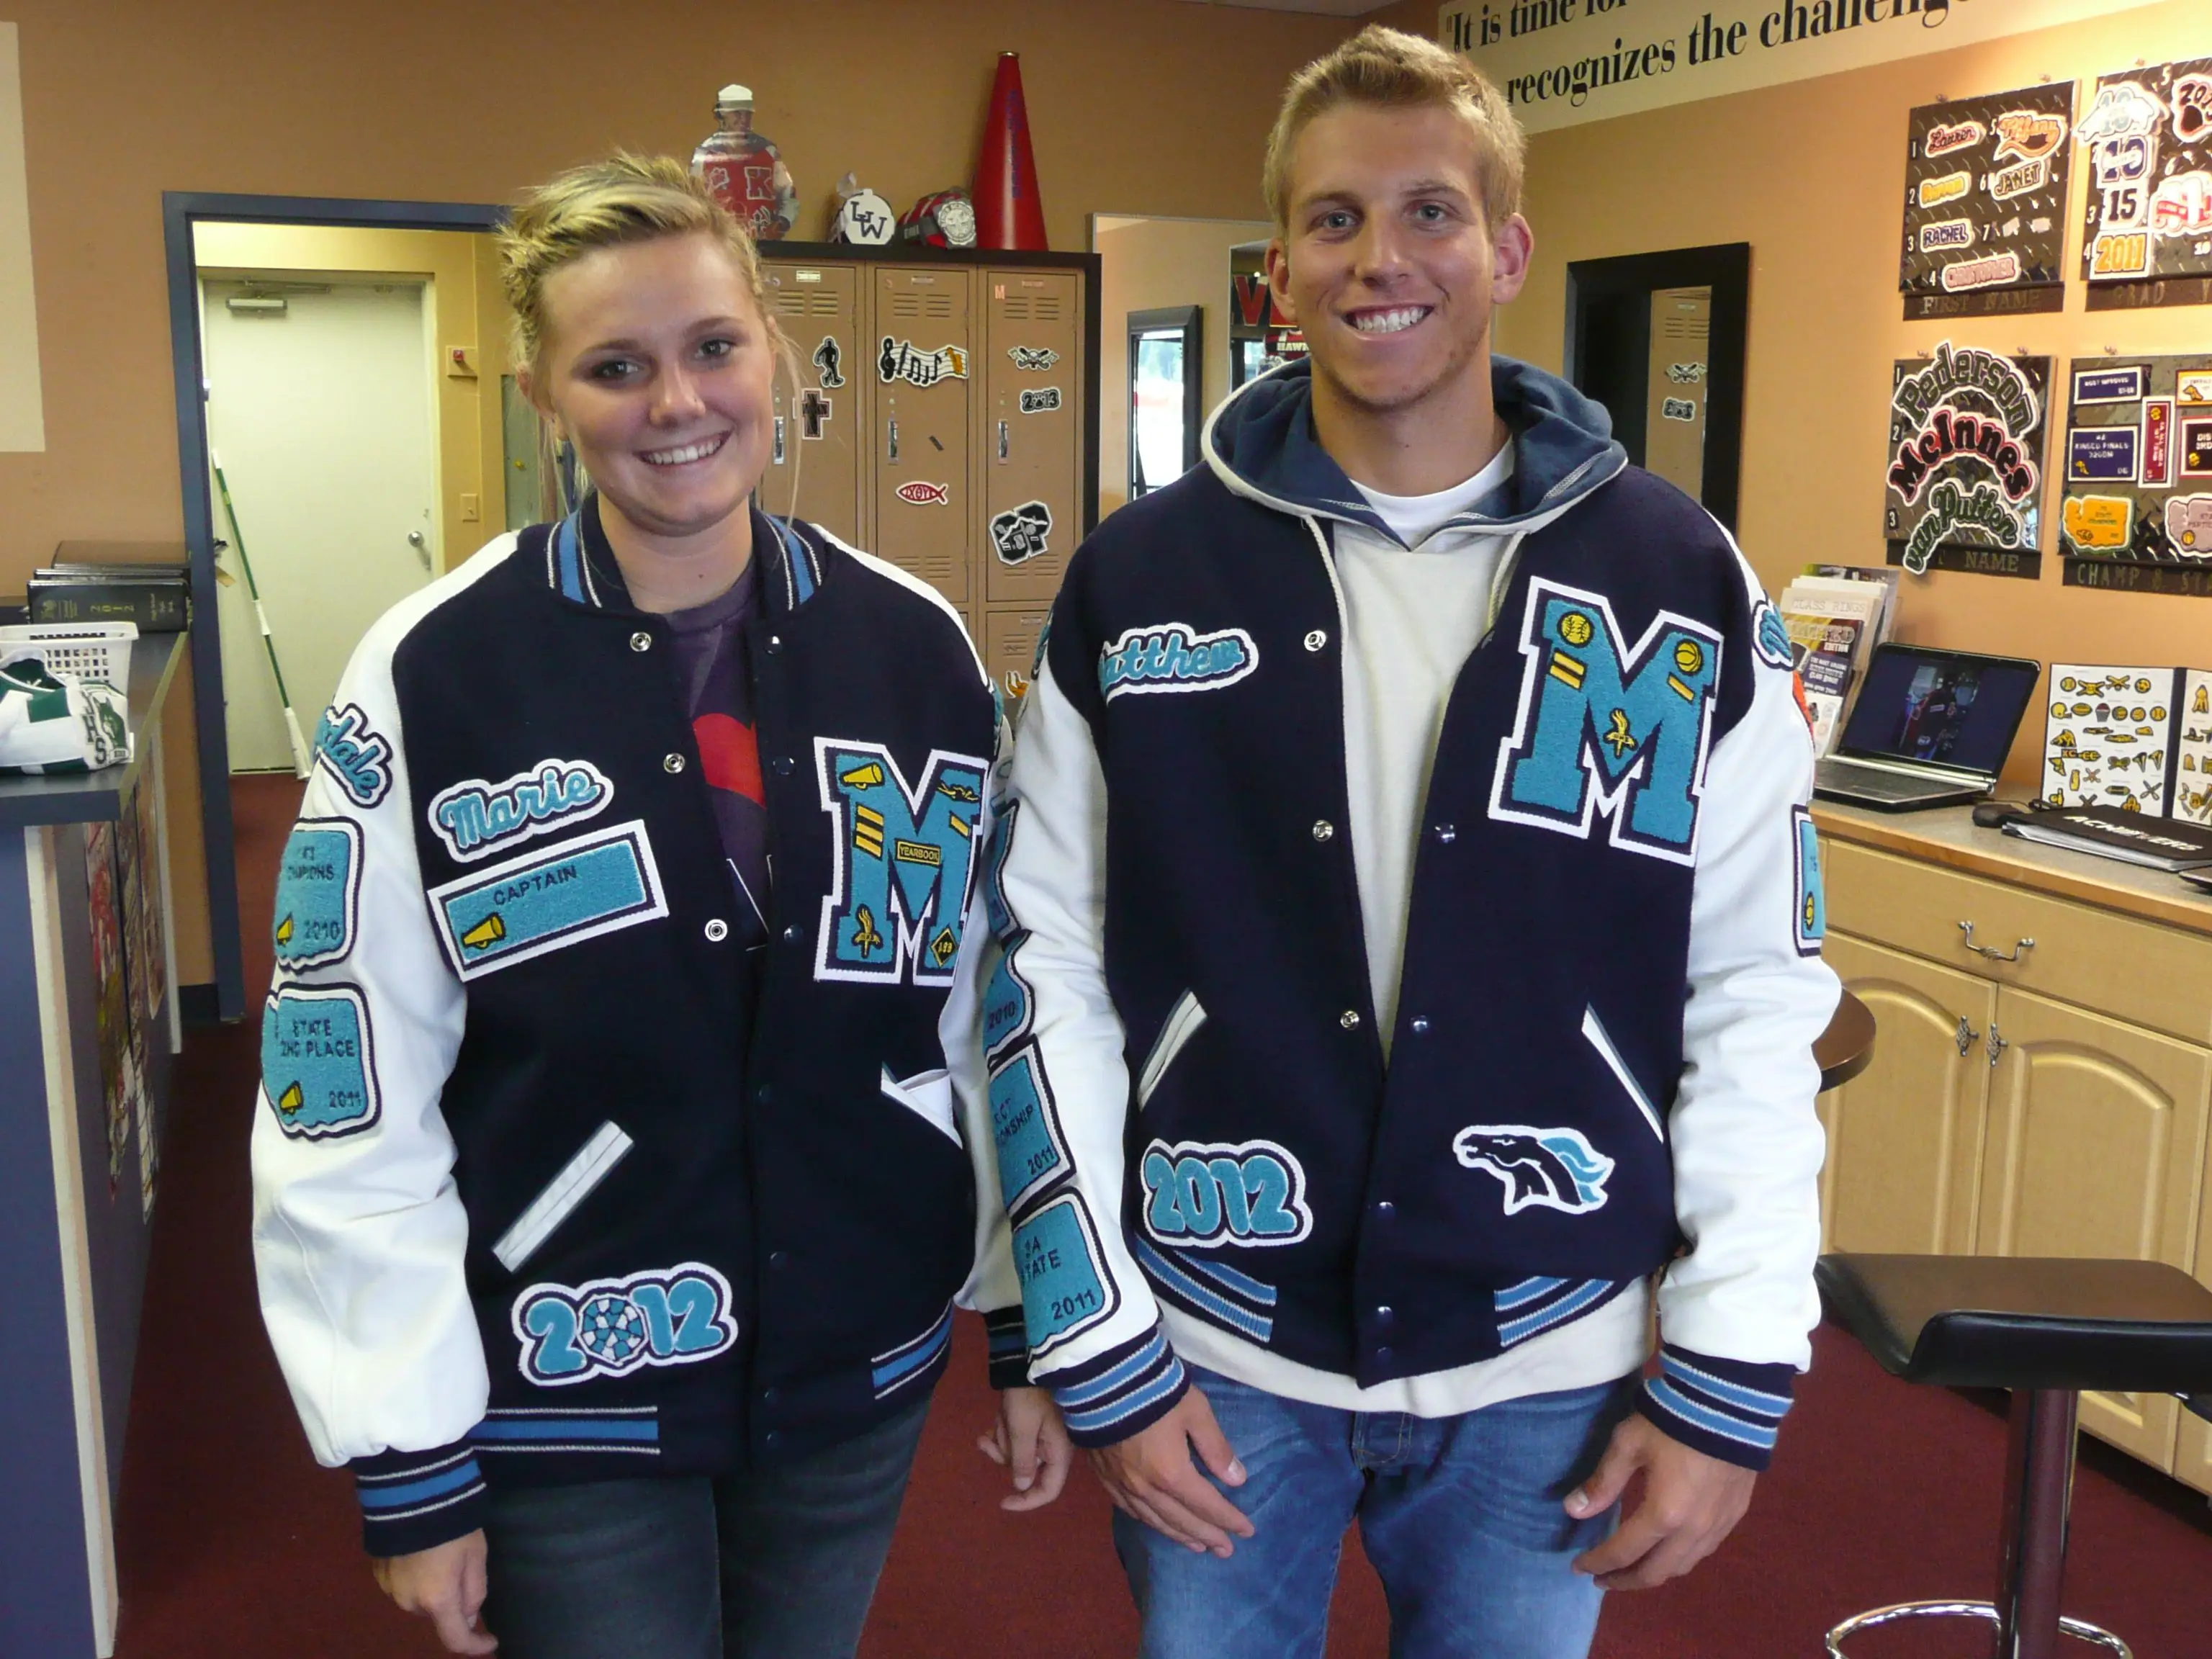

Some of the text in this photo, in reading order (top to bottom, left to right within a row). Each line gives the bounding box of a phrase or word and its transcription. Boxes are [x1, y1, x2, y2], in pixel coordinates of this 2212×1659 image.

[1479, 4, 1501, 46] is
[1511, 0, 1576, 37] time
[1507, 0, 1969, 107] recognizes the challeng
[1928, 125, 1976, 153] Lauren
[1995, 161, 2041, 196] JANET
[2108, 188, 2137, 221] 15
[1923, 223, 1969, 246] RACHEL
[2095, 234, 2145, 271] 2011
[1920, 289, 2041, 315] FIRST NAME
[1894, 343, 2033, 437] Pederson
[1889, 410, 2033, 503] McInnes
[1964, 551, 2019, 572] NAME
[2077, 563, 2140, 587] CHAMP
[1792, 598, 1866, 613] CLASS RINGS
[1492, 580, 1722, 863] M
[439, 768, 601, 848] Marie
[819, 742, 987, 982] M
[899, 846, 940, 862] YEARBOOK
[494, 865, 577, 905] CAPTAIN
[292, 1018, 332, 1037] STATE
[989, 1000, 1016, 1030] 2010
[306, 1039, 356, 1058] PLACE
[328, 1089, 362, 1108] 2011
[1027, 1145, 1056, 1175] 2011
[1145, 1153, 1298, 1235] 2012
[1051, 1288, 1096, 1321] 2011
